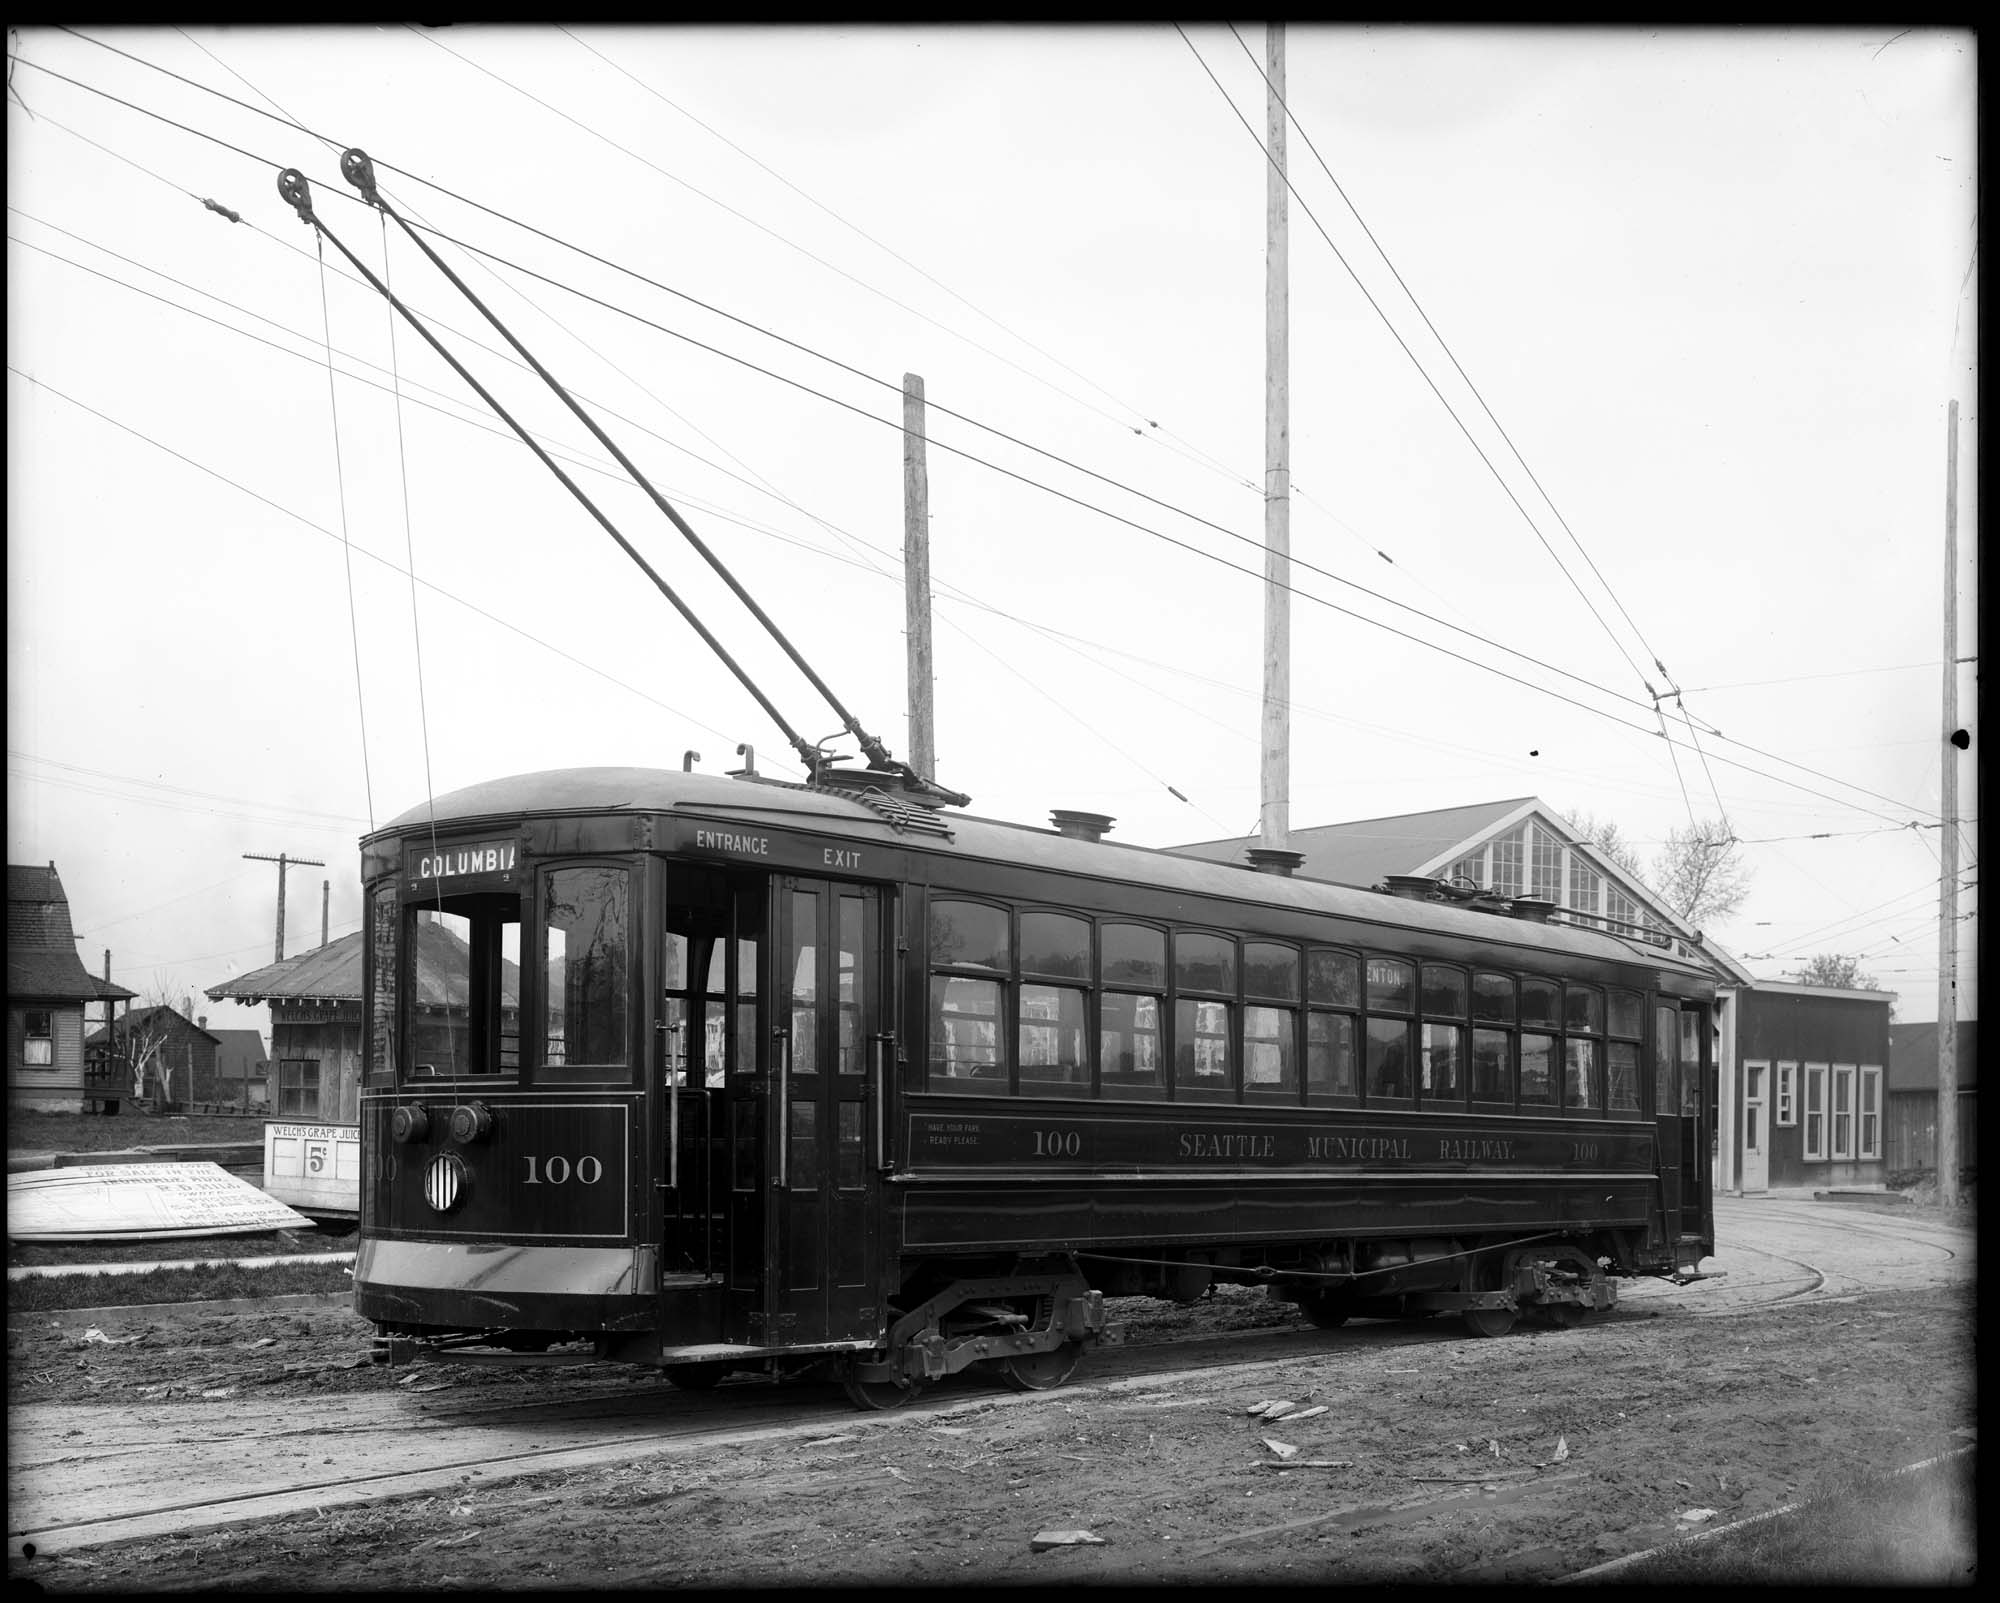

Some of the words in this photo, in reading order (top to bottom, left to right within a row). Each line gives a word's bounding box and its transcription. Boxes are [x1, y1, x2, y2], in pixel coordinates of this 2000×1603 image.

[696, 830, 768, 855] ENTRANCE
[823, 848, 861, 869] EXIT
[273, 1126, 306, 1137] WELCH'S
[308, 1127, 337, 1139] GRAPE
[1032, 1131, 1081, 1156] 100
[1179, 1133, 1276, 1158] SEATTLE
[1307, 1136, 1412, 1160] MUNICIPAL
[1572, 1143, 1599, 1161] 100
[521, 1155, 603, 1185] 100
